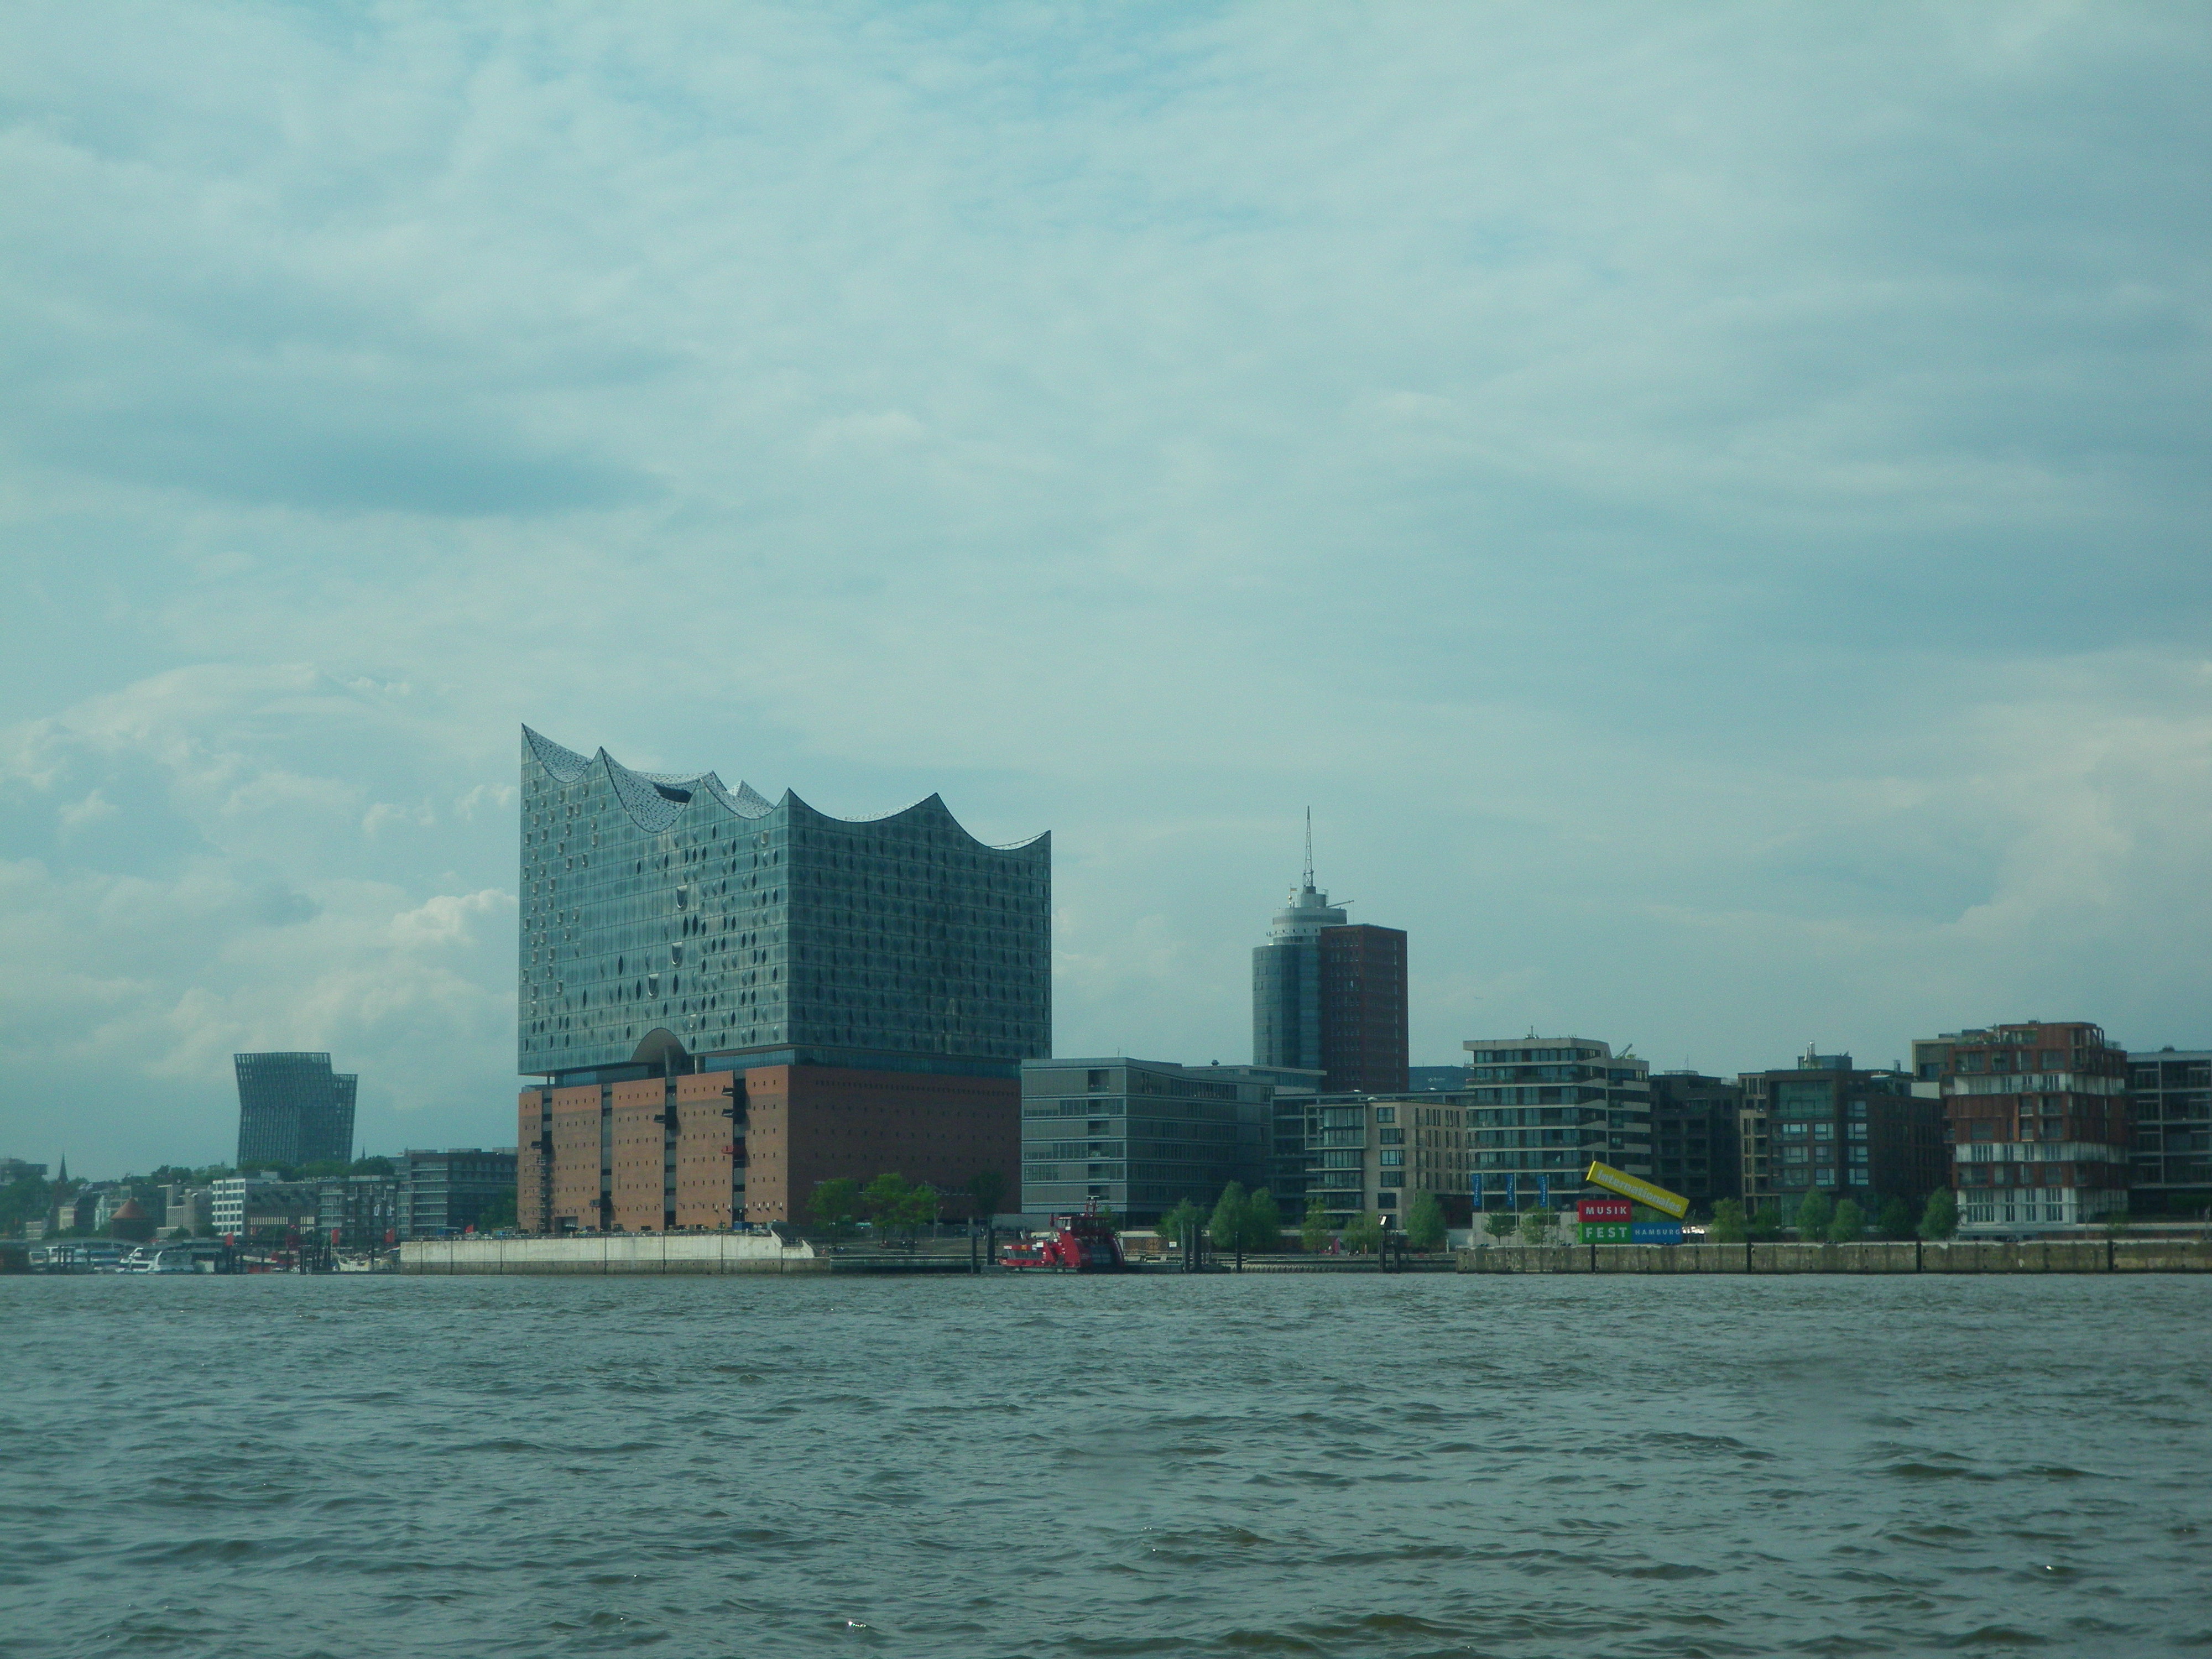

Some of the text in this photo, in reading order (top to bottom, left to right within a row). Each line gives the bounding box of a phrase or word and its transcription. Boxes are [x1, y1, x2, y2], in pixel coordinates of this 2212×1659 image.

[1597, 1170, 1682, 1212] Internationales
[1585, 1206, 1627, 1214] MUSIK
[1585, 1227, 1627, 1238] FEST
